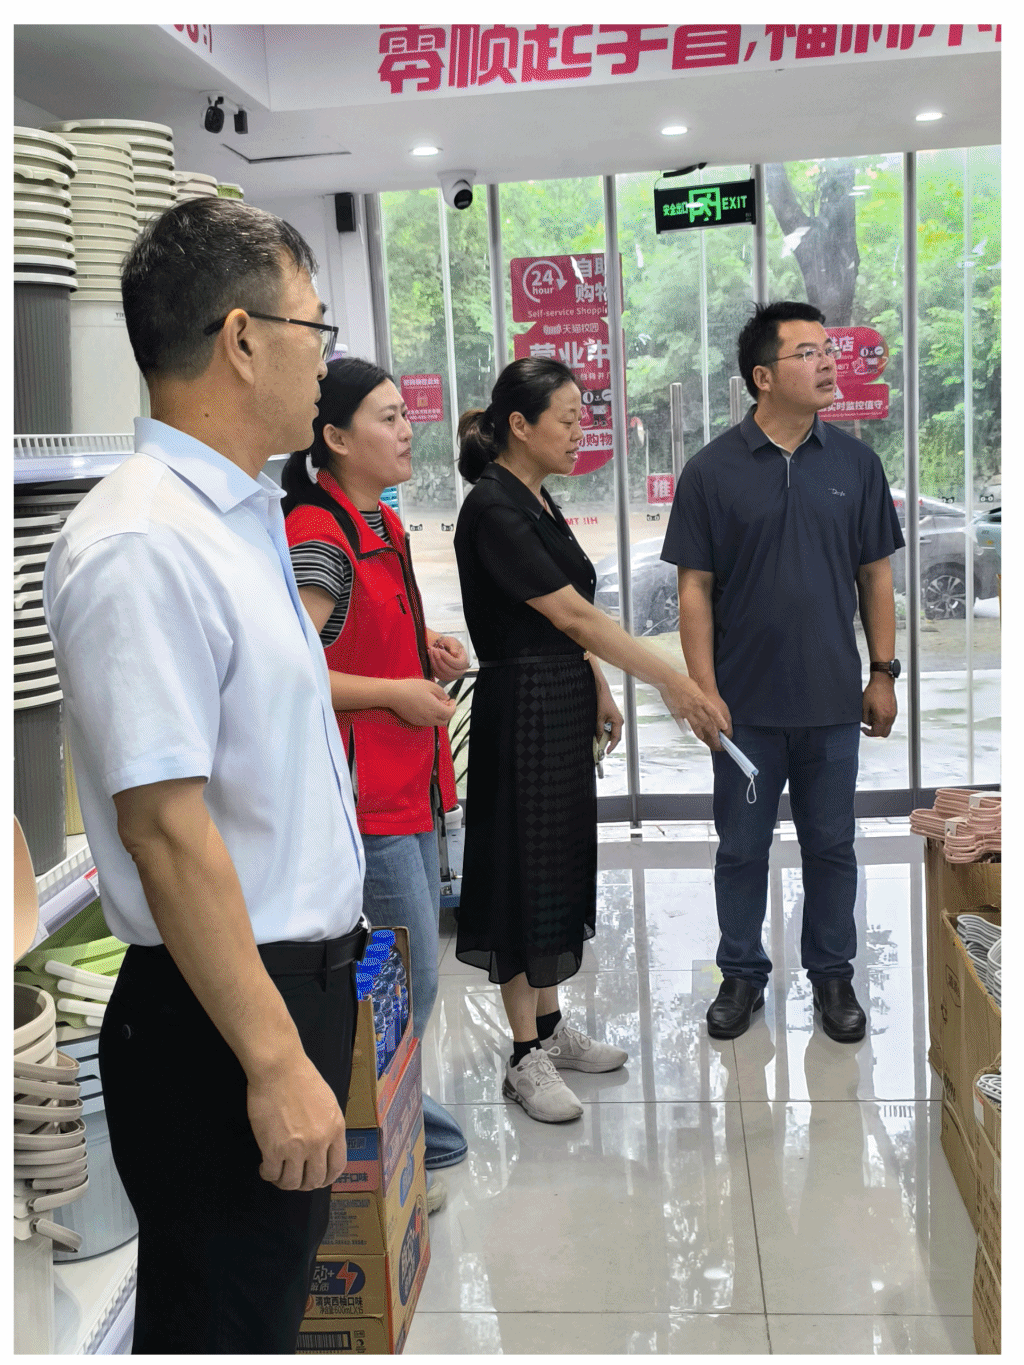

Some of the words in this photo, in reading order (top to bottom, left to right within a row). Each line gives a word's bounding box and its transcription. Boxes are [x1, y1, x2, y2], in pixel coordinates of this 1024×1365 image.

[722, 195, 747, 210] EXIT
[531, 270, 554, 286] 24
[532, 285, 554, 295] hour
[527, 309, 574, 319] Self-service
[653, 479, 671, 498] 推
